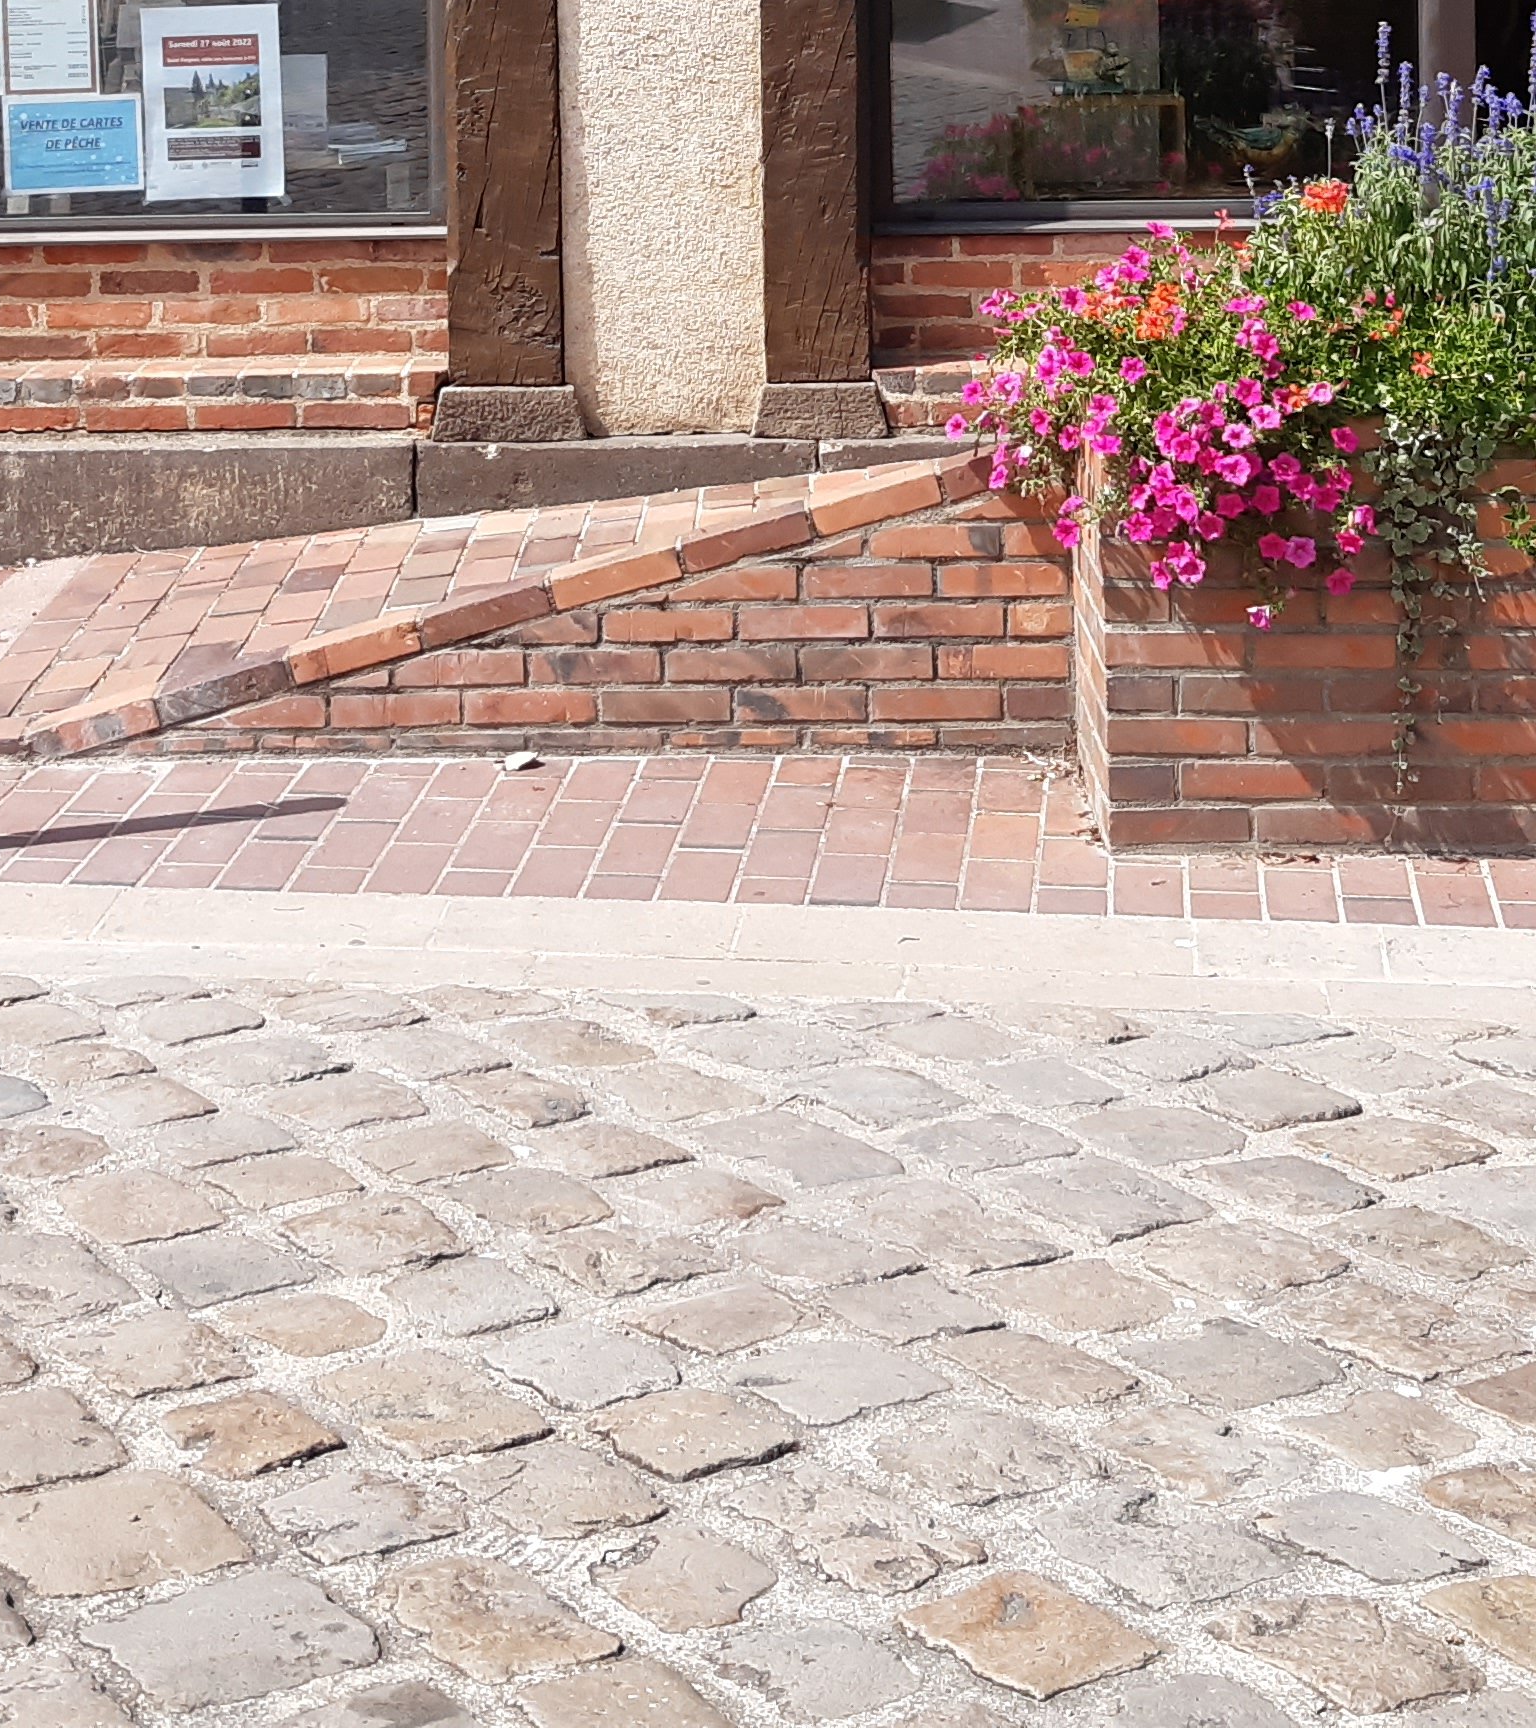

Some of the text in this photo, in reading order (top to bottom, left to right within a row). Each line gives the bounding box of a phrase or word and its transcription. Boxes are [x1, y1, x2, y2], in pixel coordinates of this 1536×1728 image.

[20, 116, 124, 130] VENTE DE CARTES
[45, 139, 62, 150] DE
